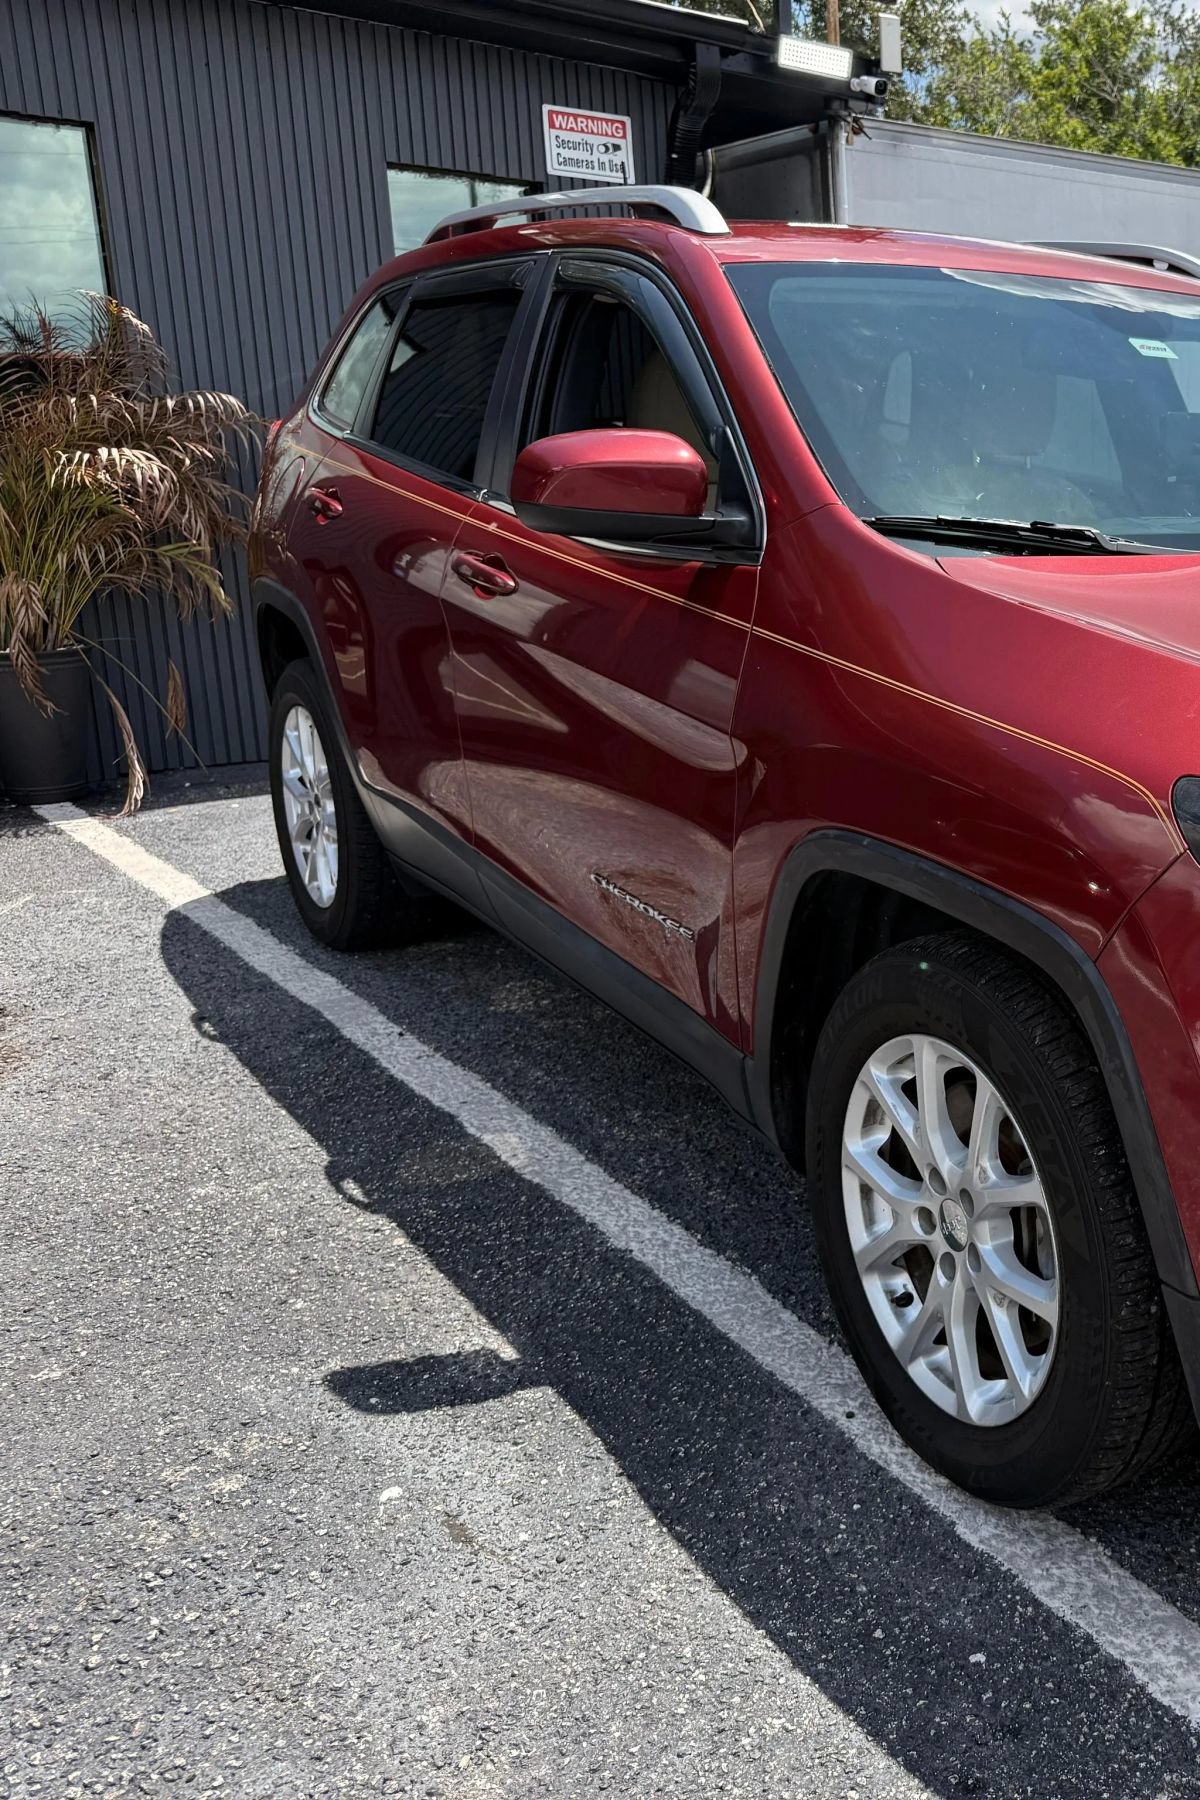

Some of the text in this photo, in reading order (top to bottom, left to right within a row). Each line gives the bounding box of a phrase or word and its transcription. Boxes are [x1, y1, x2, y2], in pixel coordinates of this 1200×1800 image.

[552, 113, 623, 137] WARNING
[555, 135, 594, 156] Security
[556, 152, 624, 174] Cameras In Use
[590, 873, 695, 941] CHEROKEE
[998, 1058, 1076, 1217] ZETA
